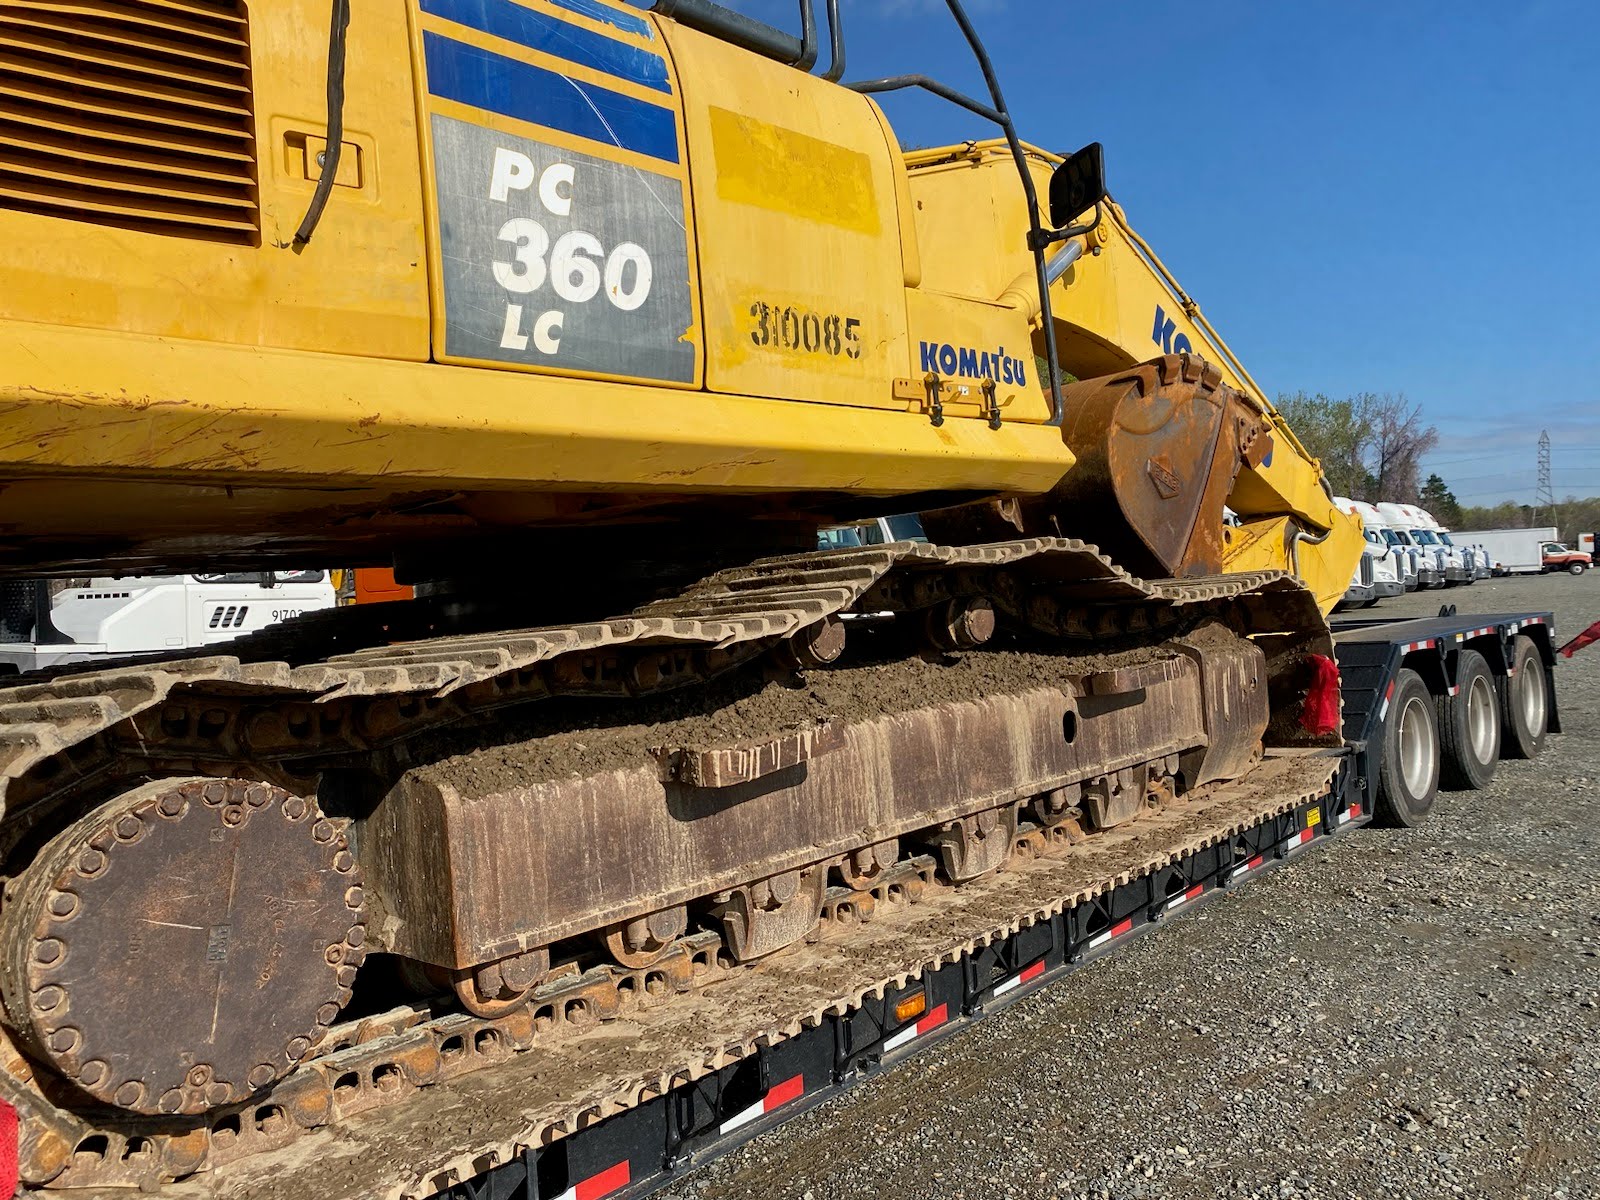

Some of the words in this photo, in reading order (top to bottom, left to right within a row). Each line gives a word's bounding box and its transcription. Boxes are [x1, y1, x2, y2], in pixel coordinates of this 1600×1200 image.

[489, 147, 575, 216] PC
[492, 217, 652, 311] 360
[500, 304, 564, 355] LC
[750, 301, 861, 359] 310085
[920, 340, 1027, 387] KOMATSU
